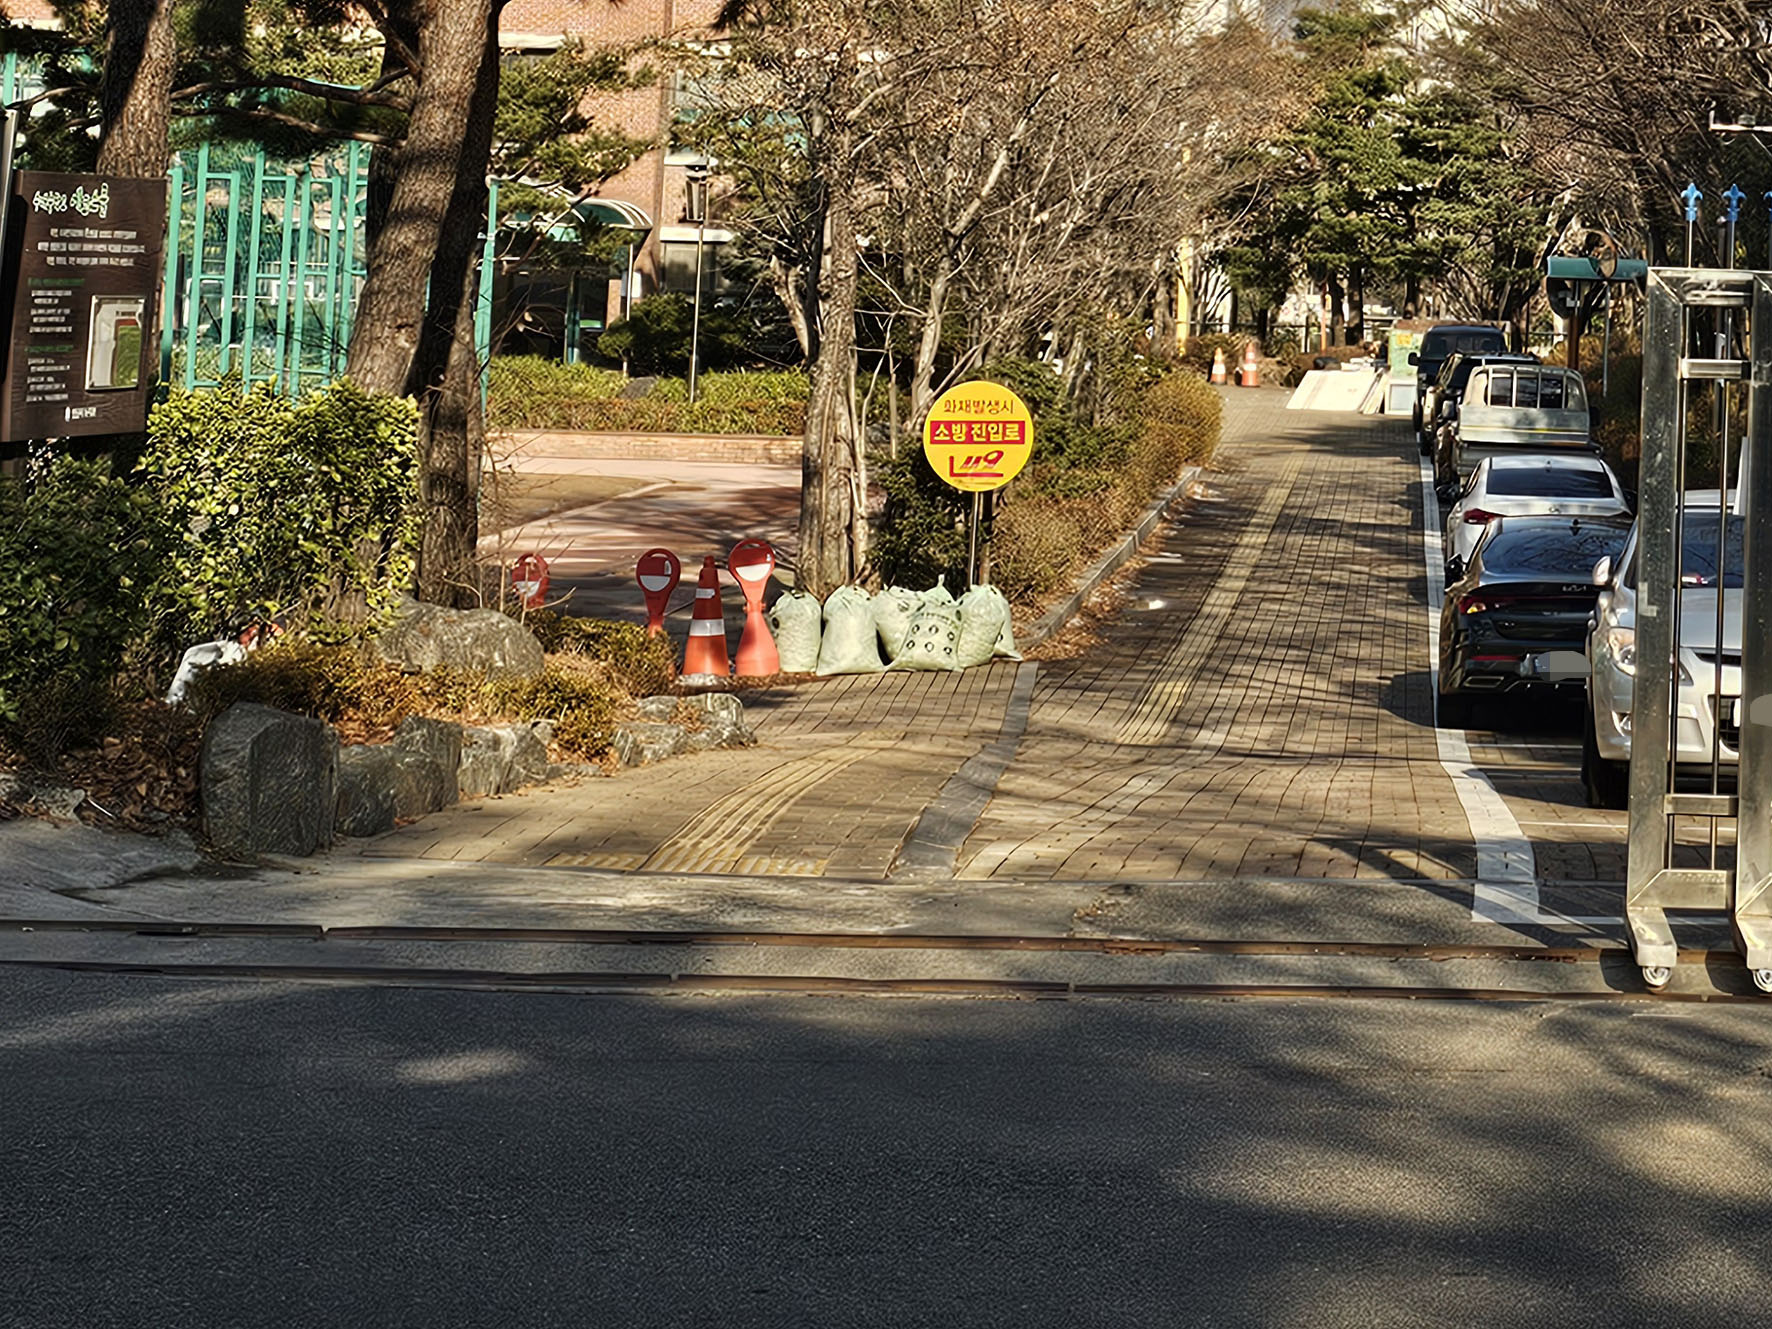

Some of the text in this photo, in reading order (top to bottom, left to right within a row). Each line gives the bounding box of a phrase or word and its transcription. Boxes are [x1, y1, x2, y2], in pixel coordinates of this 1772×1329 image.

[944, 399, 1014, 415] 화재발생시
[934, 423, 1021, 442] 소방 진입로
